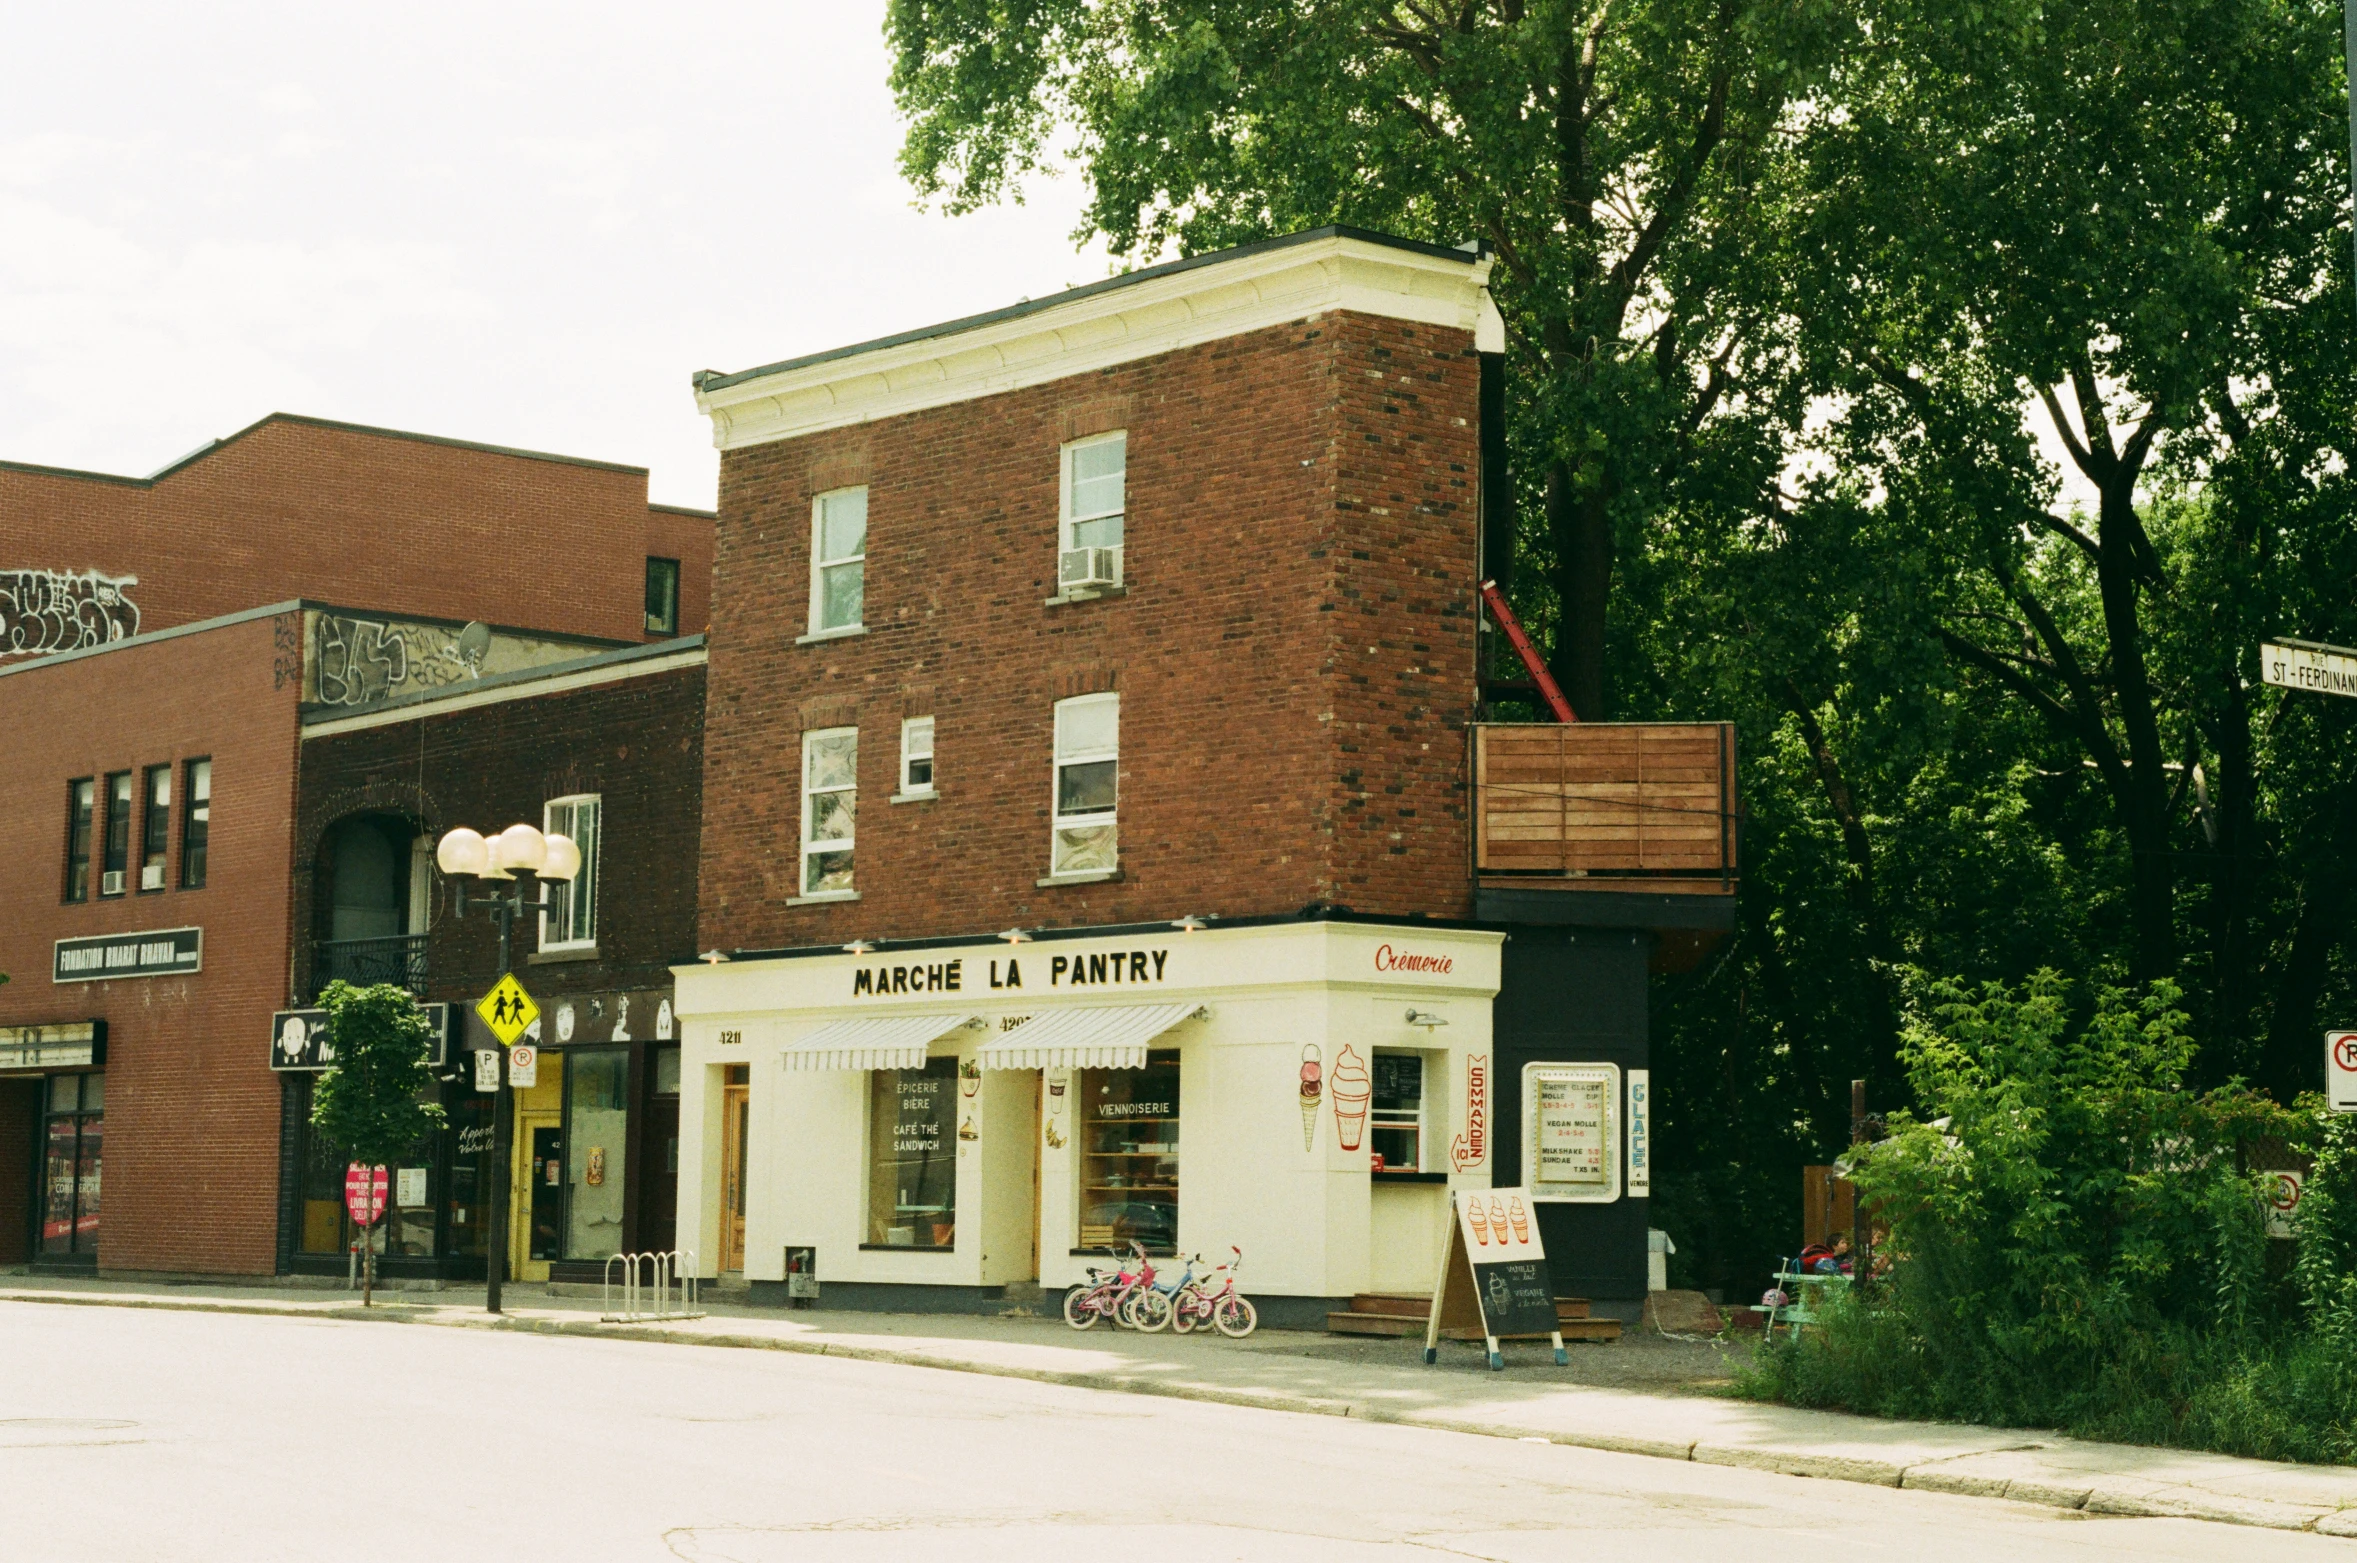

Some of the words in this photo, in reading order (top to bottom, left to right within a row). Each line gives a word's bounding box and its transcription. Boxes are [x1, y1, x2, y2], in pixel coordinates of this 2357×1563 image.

[60, 947, 103, 971] FONDATION
[105, 944, 138, 968] BHARAT
[140, 941, 175, 966] BHAVAN
[1375, 944, 1453, 974] Crèmerie
[853, 959, 963, 997] MARCHÉ
[989, 959, 1022, 989] LA
[1051, 950, 1168, 986] PANTRY
[1000, 1015, 1032, 1033] 420
[719, 1031, 742, 1044] 4211
[897, 1081, 939, 1094] ÉPICERIE
[903, 1096, 930, 1110] BIÈRE
[1586, 1093, 1599, 1101] DIP
[1099, 1102, 1170, 1116] VIENNOISERIE
[1470, 1067, 1484, 1158] COMMANDEZ
[893, 1121, 918, 1135] CAFÉ
[920, 1121, 939, 1135] THÉ
[1632, 1083, 1646, 1168] GLACE
[459, 1124, 494, 1142] Apport
[893, 1140, 940, 1151] SANDWICH
[1456, 1148, 1469, 1160] ICI
[350, 1197, 382, 1209] LIVRAON
